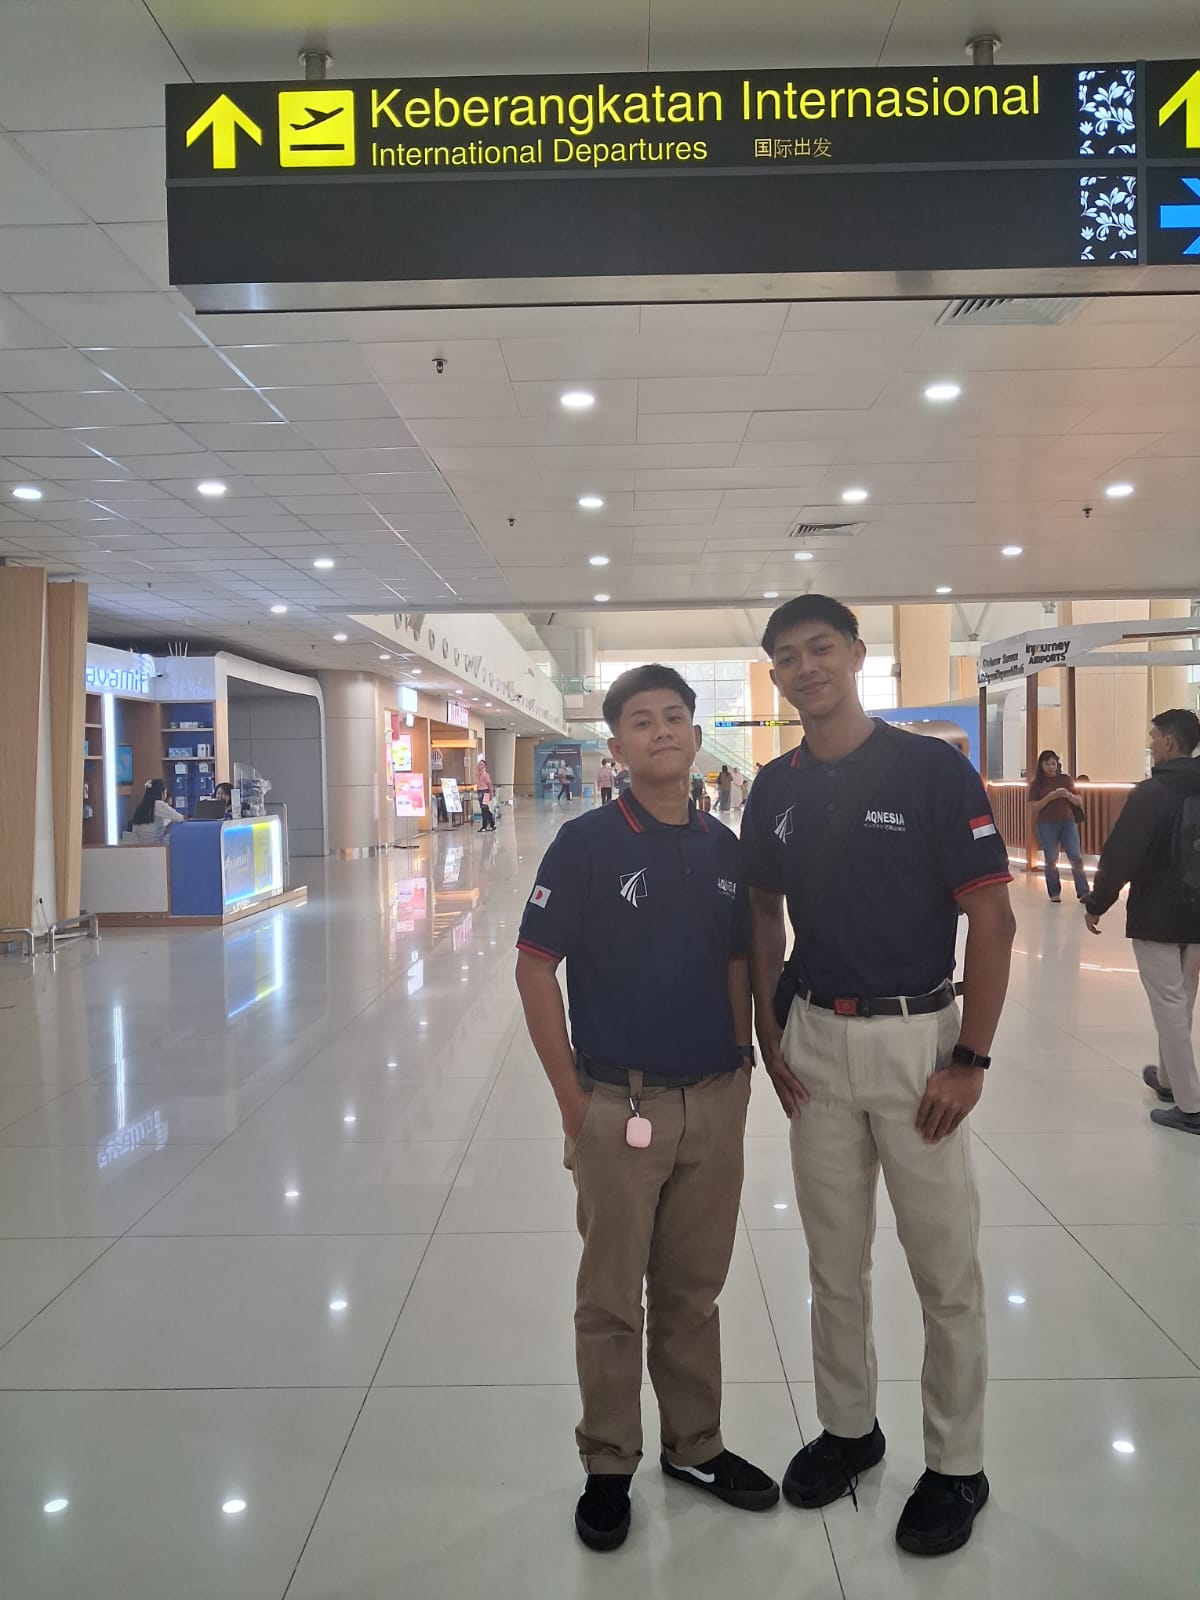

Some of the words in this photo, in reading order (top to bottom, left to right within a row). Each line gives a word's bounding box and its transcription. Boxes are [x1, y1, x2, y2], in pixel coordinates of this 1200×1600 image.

[371, 83, 723, 136] Keberangkatan
[743, 74, 1039, 121] Internasional
[372, 138, 542, 167] International
[553, 138, 708, 169] Departures
[754, 137, 832, 159] 国际出发
[1028, 652, 1066, 665] AIRPORTS
[864, 809, 905, 825] AQNESIA
